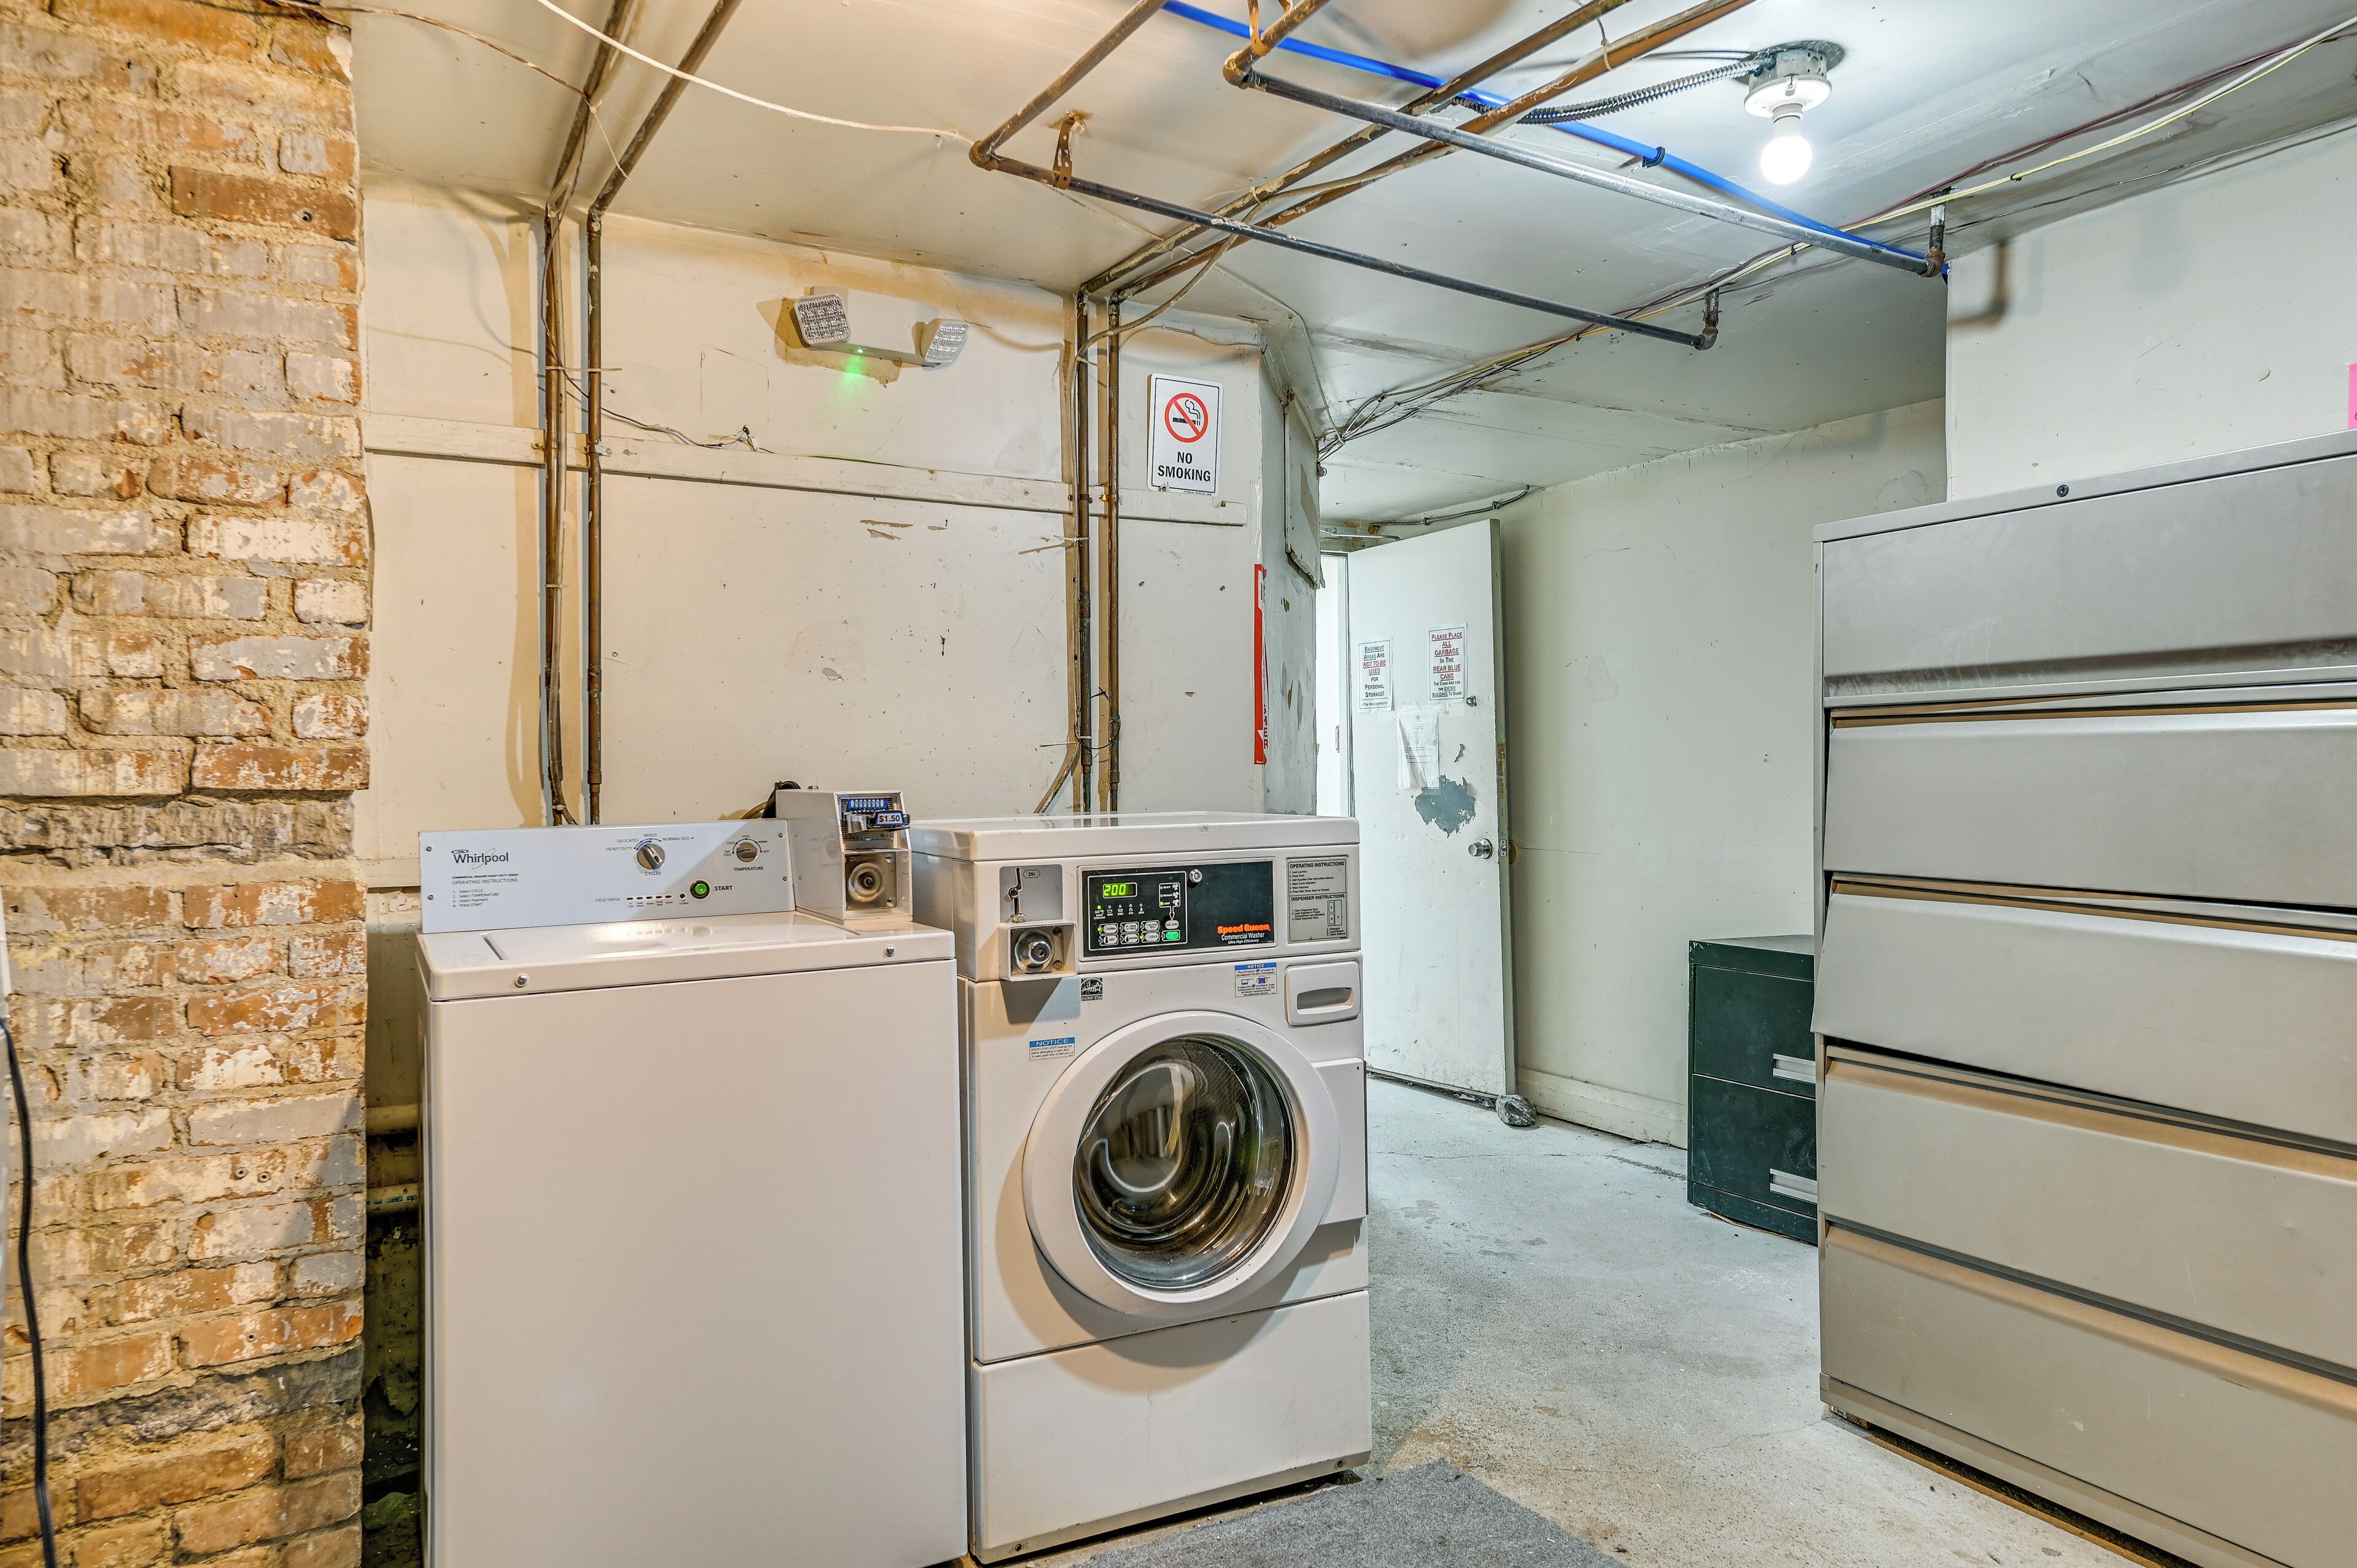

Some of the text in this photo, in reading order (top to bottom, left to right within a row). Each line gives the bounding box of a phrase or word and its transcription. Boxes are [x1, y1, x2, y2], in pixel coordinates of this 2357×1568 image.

[1177, 452, 1193, 464] NO
[1158, 465, 1211, 482] SMOKING
[453, 852, 509, 865] Whirlpool
[1104, 884, 1126, 897] 200
[1217, 924, 1244, 935] Speed
